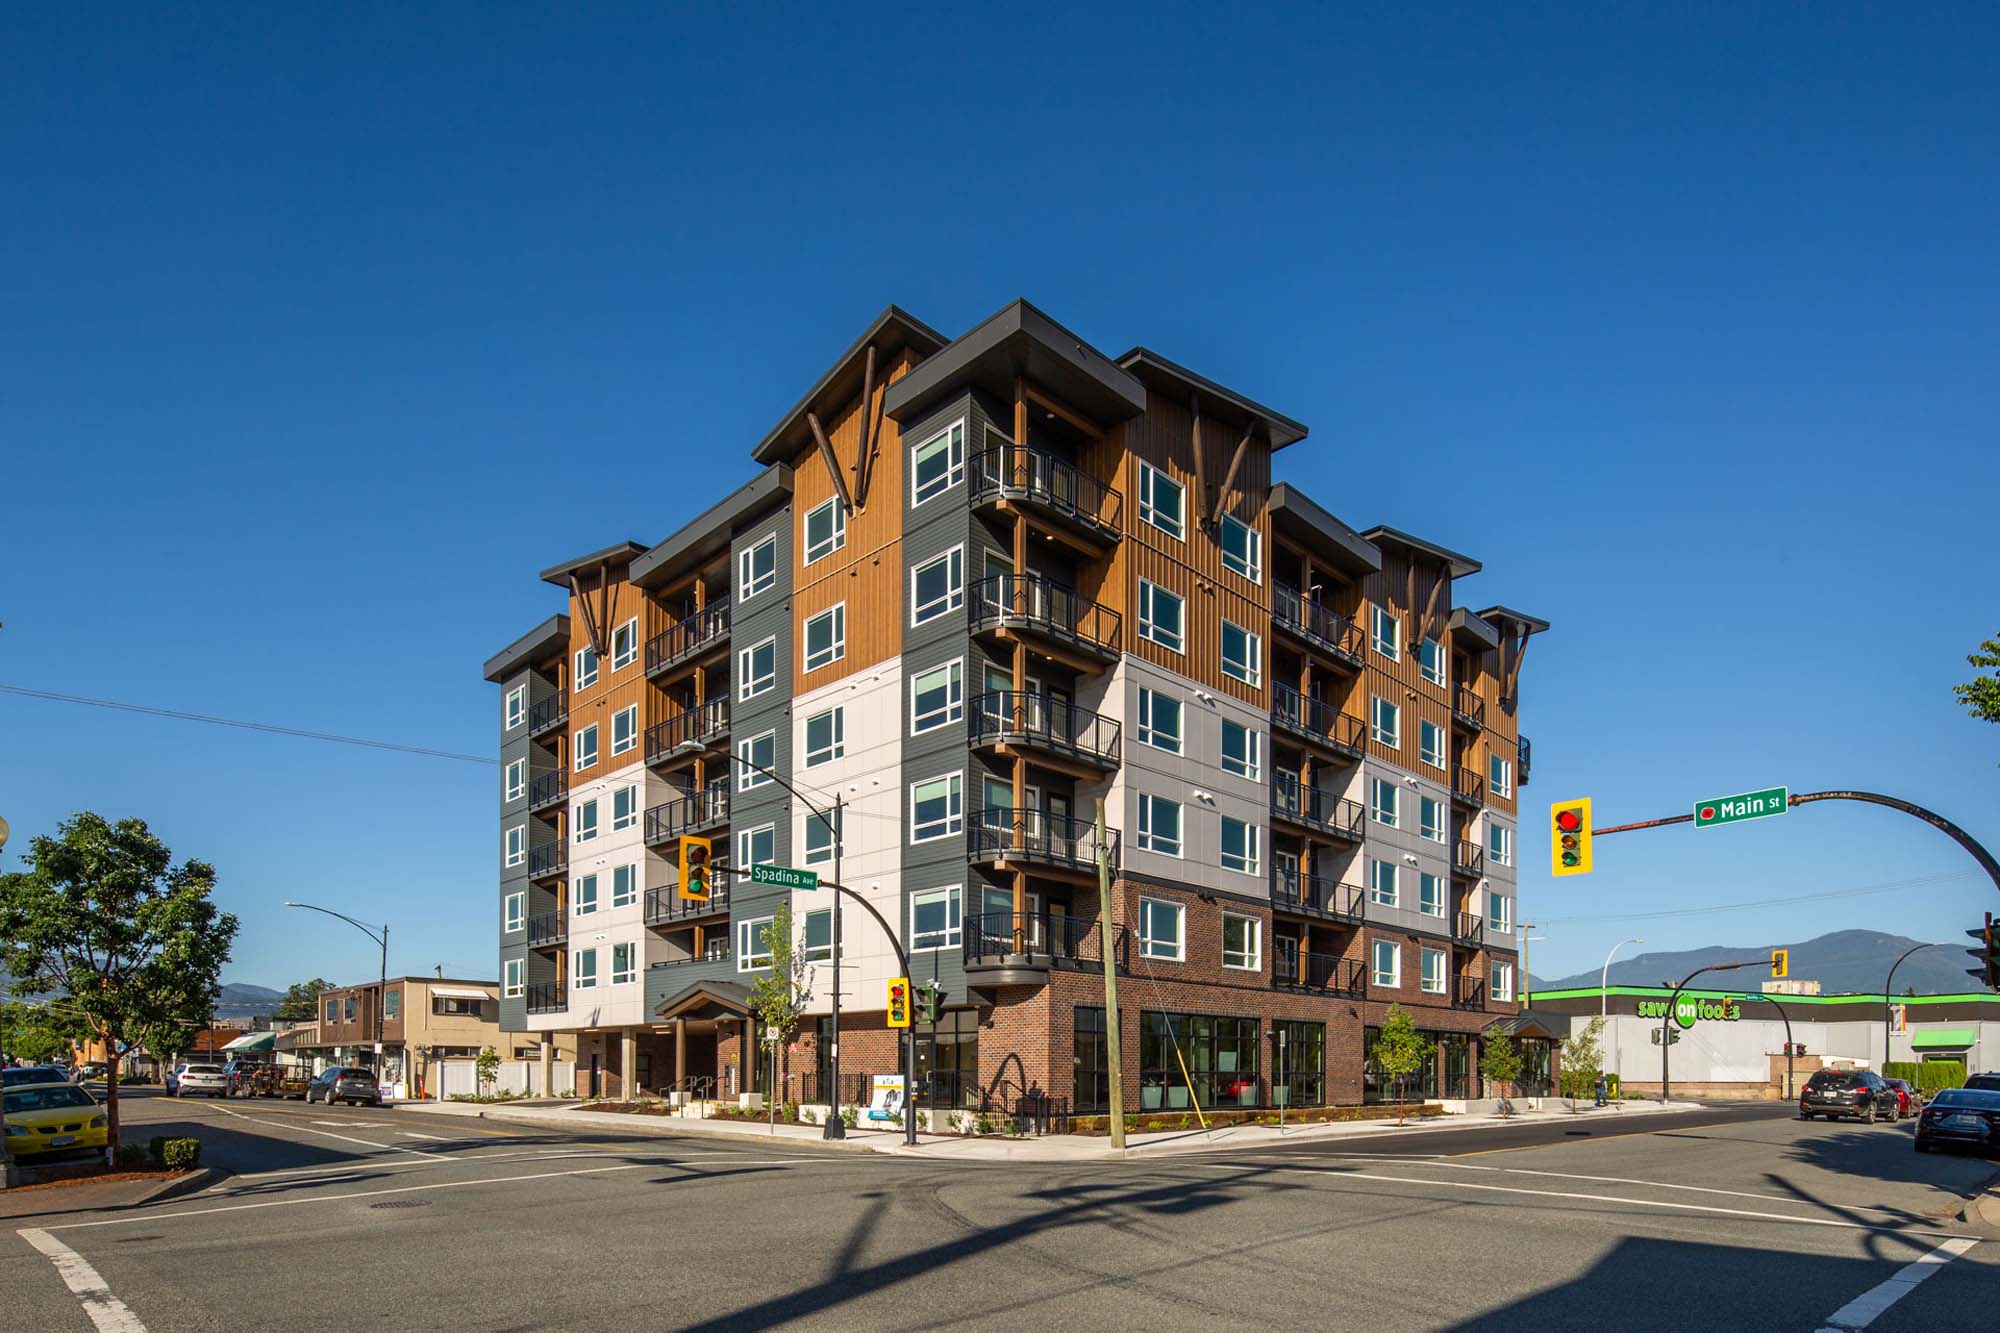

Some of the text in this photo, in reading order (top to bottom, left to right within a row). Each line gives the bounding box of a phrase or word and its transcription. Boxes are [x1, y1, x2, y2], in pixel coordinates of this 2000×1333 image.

[1721, 797, 1780, 818] Main St
[754, 866, 815, 886] Spadina Ave
[1677, 1003, 1697, 1018] on
[1697, 999, 1741, 1020] foos
